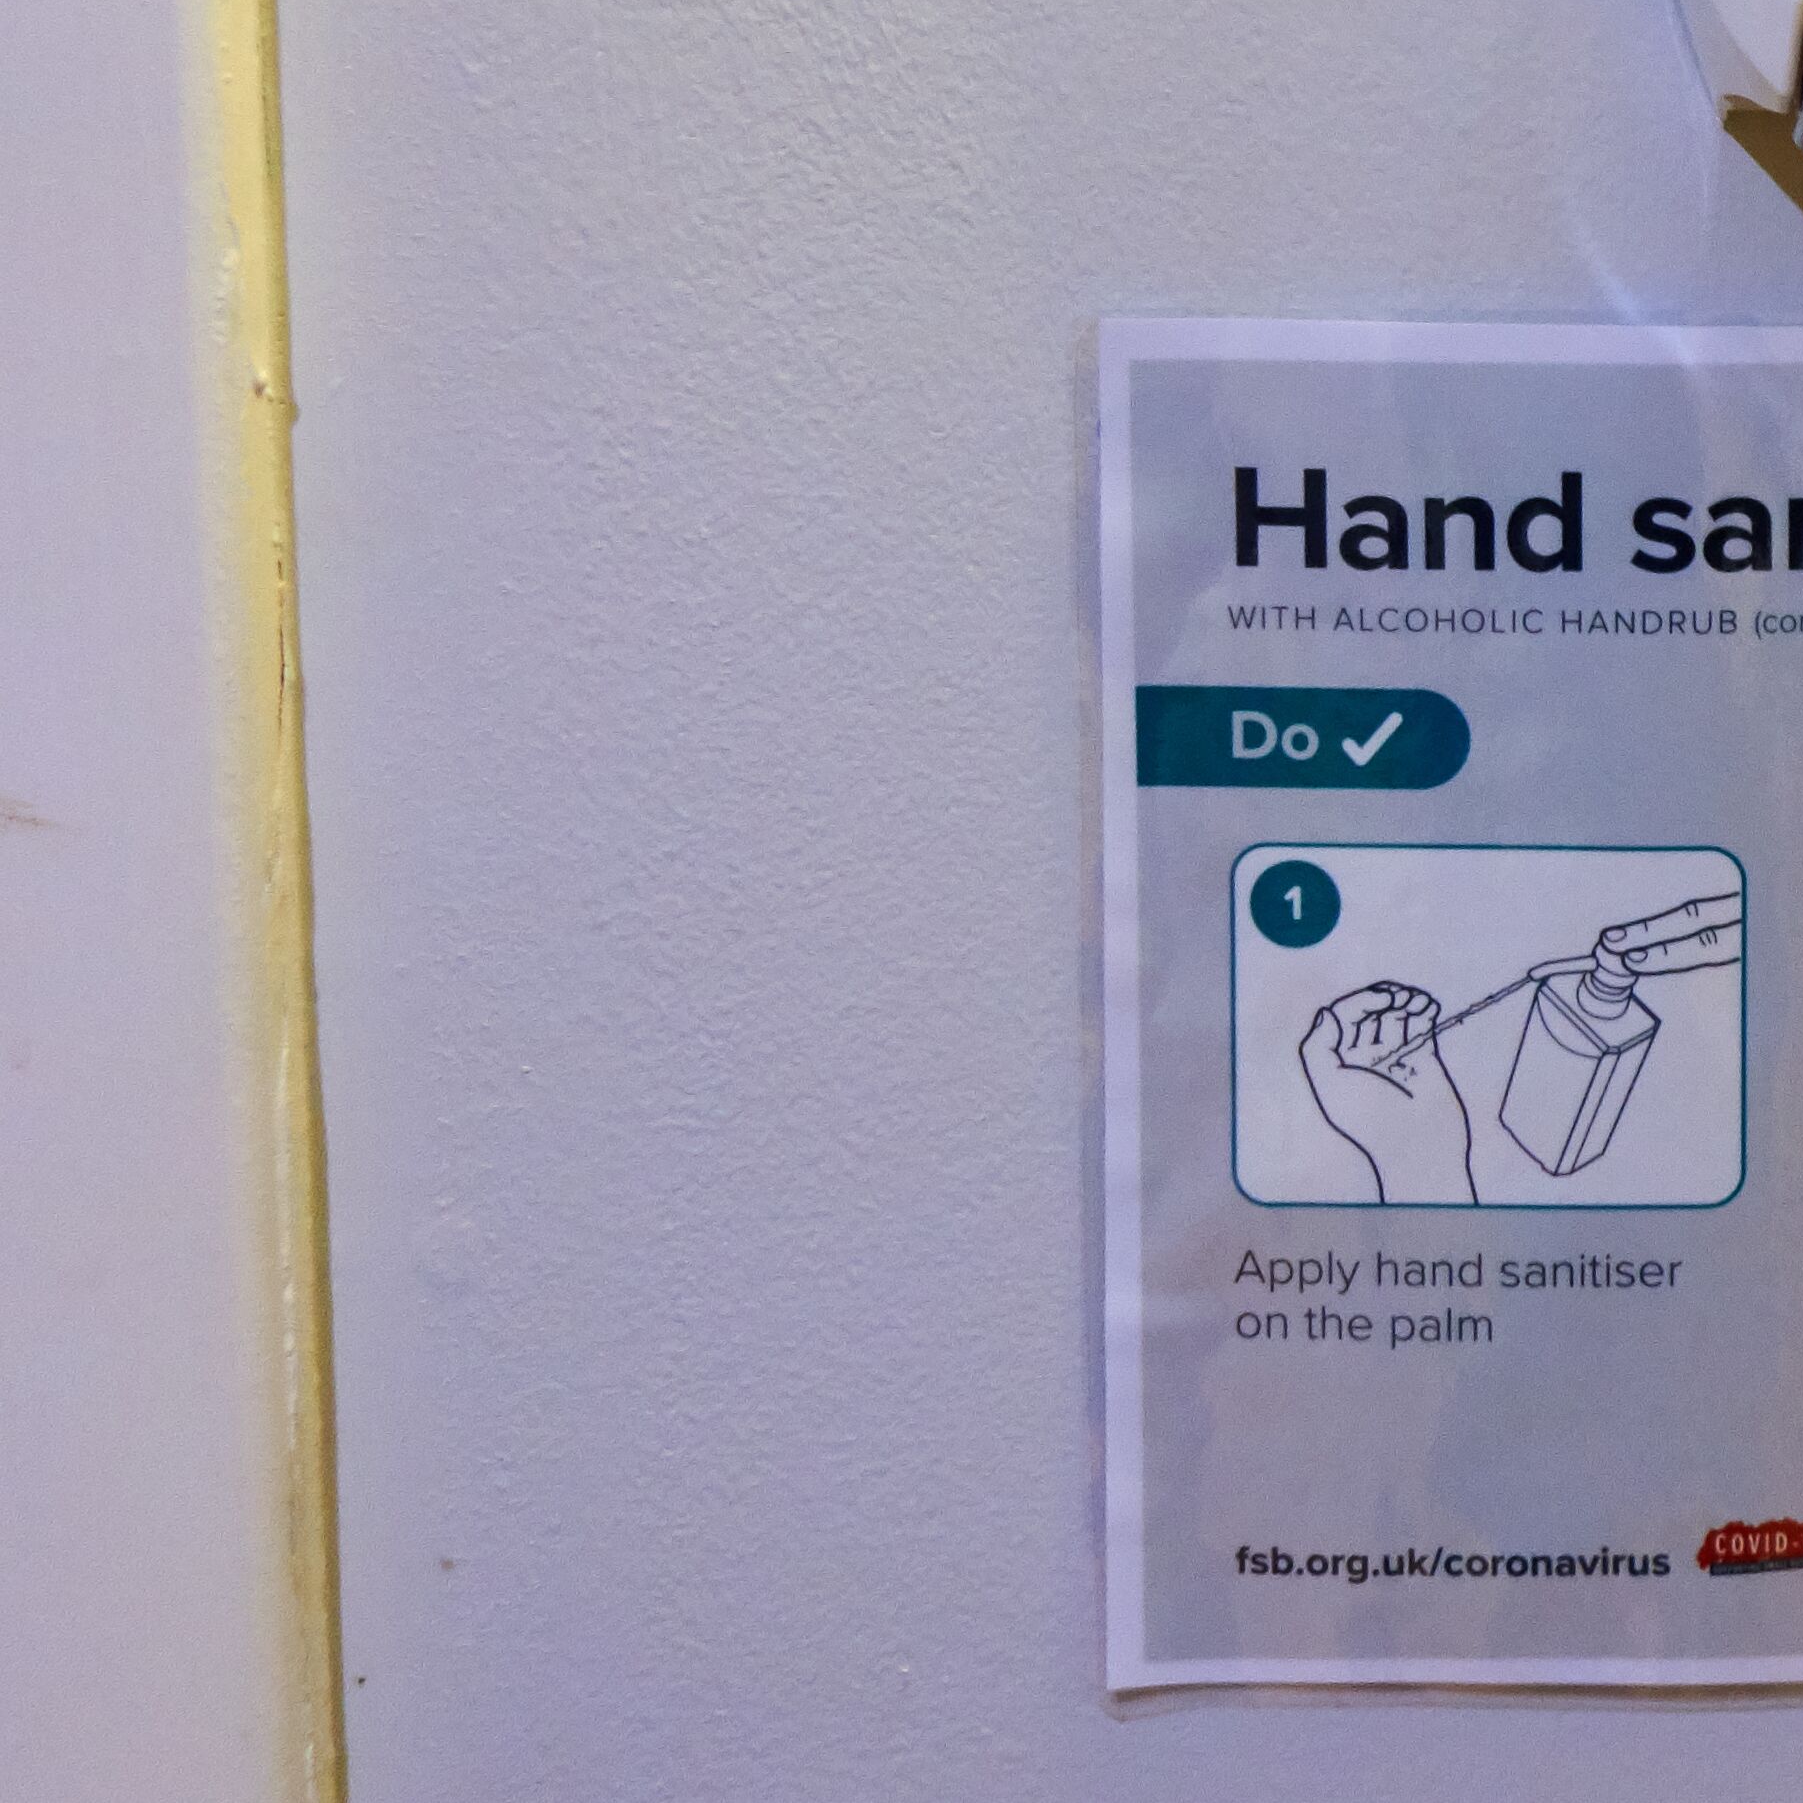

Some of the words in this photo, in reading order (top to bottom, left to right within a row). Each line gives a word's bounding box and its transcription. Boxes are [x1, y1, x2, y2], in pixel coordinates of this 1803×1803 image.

[1231, 464, 1586, 574] Hand
[1226, 603, 1318, 634] WITH
[1332, 605, 1544, 637] ALCOHOLIC
[1559, 607, 1739, 637] HANDRUB
[1231, 710, 1320, 762] Do
[1283, 886, 1304, 920] 1
[1234, 1249, 1360, 1295] Apply
[1376, 1250, 1483, 1289] hand
[1499, 1250, 1683, 1290] sanitiser
[1235, 1312, 1288, 1341] on
[1303, 1305, 1372, 1342] the
[1391, 1306, 1494, 1348] palm
[1235, 1546, 1670, 1583] fsb.org.uk/coronavirus
